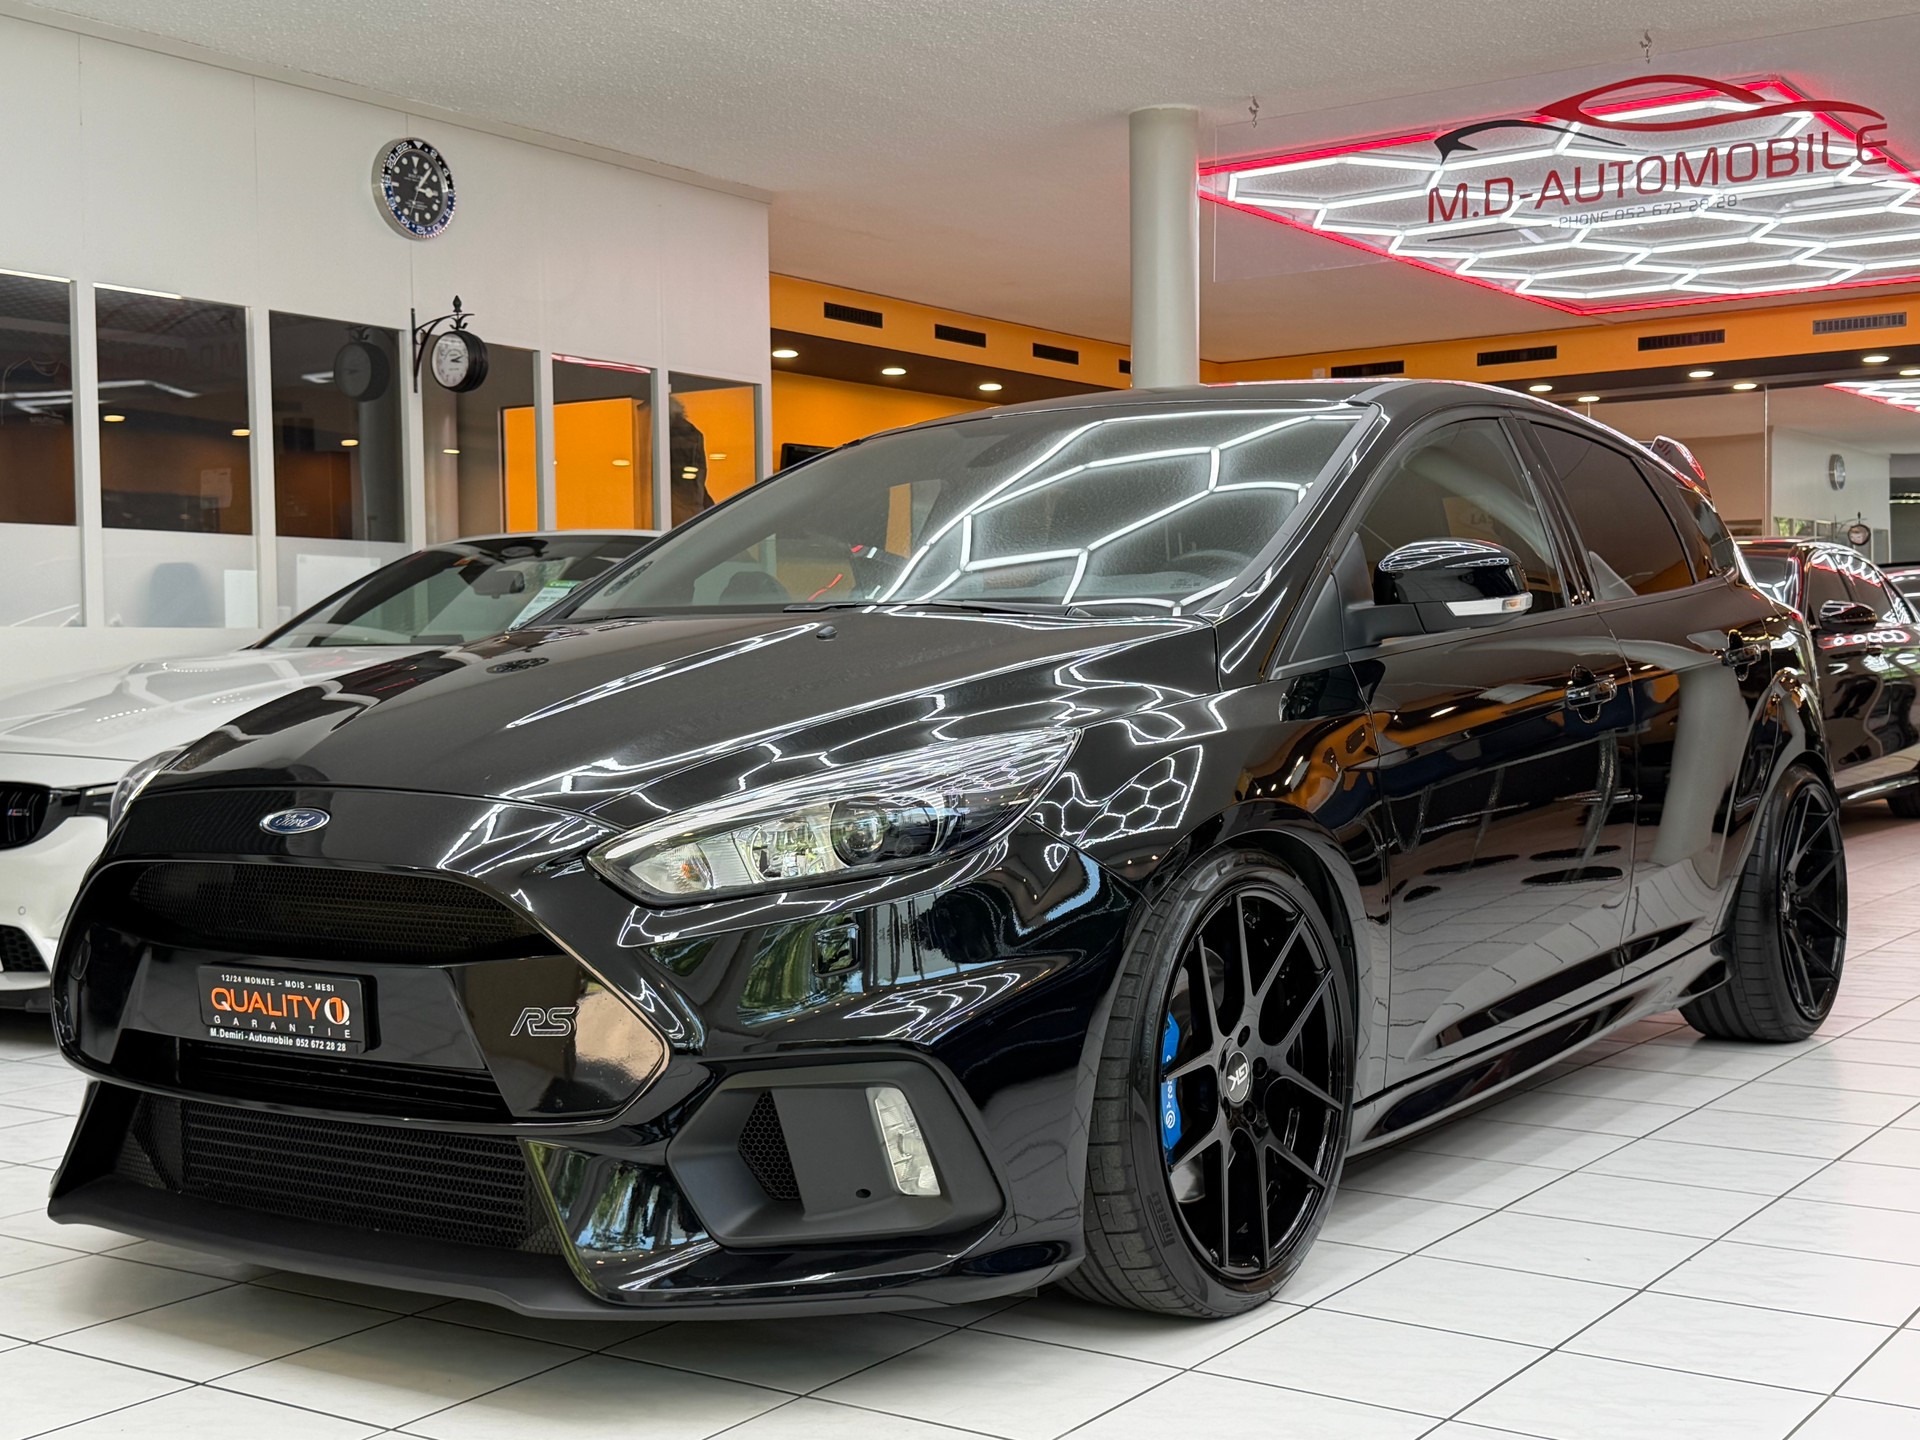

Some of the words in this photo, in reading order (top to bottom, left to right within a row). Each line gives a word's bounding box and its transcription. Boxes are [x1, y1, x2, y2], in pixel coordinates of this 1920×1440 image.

[1427, 123, 1888, 224] M.D-AUTOMOBILE
[1558, 211, 1610, 229] PHONE
[1614, 206, 1646, 220] 052
[1652, 202, 1682, 216] 672
[1716, 194, 1737, 209] 28
[221, 974, 242, 983] 12/24
[244, 976, 275, 987] MONATE
[284, 980, 305, 990] MOIS
[315, 984, 335, 992] MESI
[211, 987, 321, 1020] QUALITY
[213, 1015, 351, 1039] GARANTIE
[510, 1006, 576, 1037] RS
[295, 1039, 309, 1049] 052
[311, 1040, 325, 1050] 672
[326, 1042, 336, 1051] 28
[337, 1043, 347, 1052] 28
